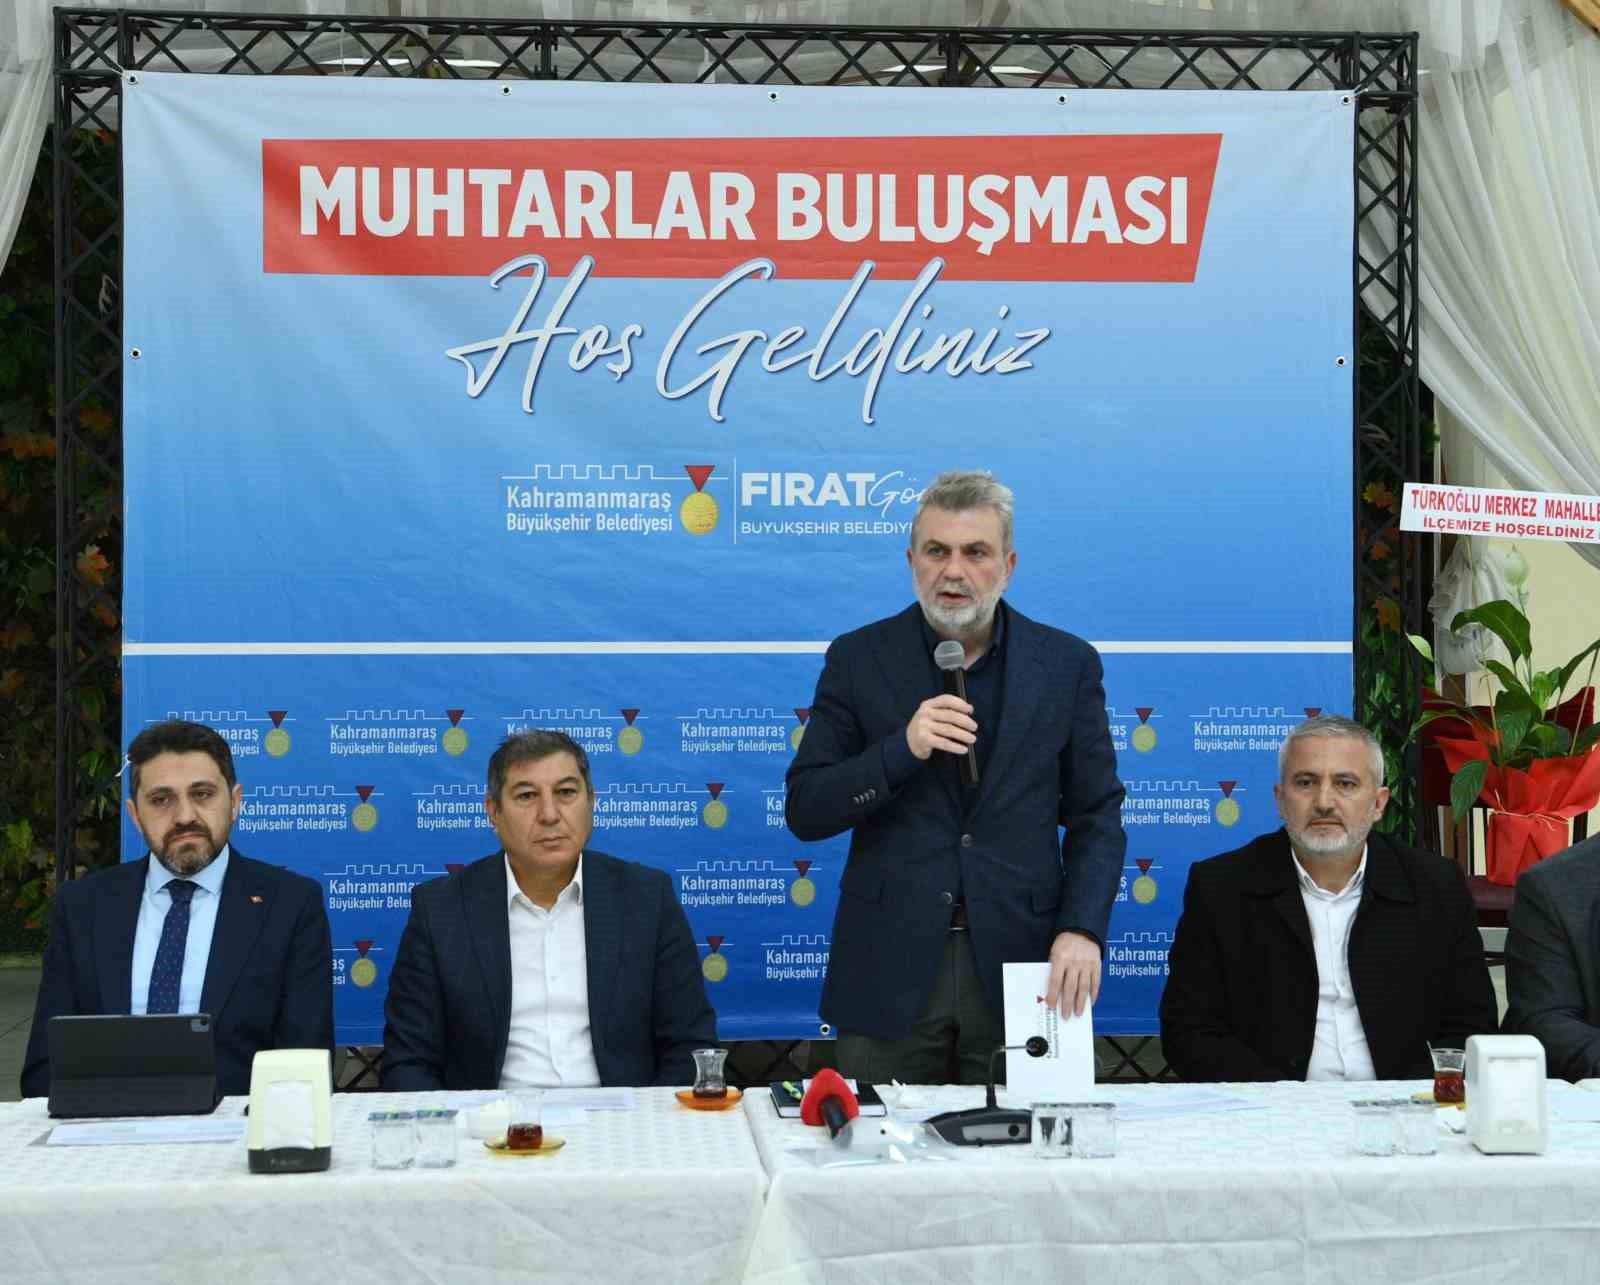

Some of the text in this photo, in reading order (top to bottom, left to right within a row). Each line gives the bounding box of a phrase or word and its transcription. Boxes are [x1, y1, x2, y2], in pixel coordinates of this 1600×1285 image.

[299, 165, 1188, 256] MUHTARLAR BULUŞMASI
[445, 254, 1051, 424] Hoş Geldiniz
[741, 472, 876, 507] FIRAT
[507, 486, 672, 511] Kahramanmaraş
[1411, 485, 1480, 514] TÜRKOĞLU
[1485, 495, 1537, 517] MERKEZ
[507, 513, 673, 535] Büyükşehir Belediyesi
[330, 723, 437, 741] Kahramanmaraş
[681, 722, 785, 739] Kahramanmaraş
[388, 741, 438, 757] Belediyesi
[737, 740, 786, 754] Belediyesi
[239, 800, 346, 816] Kahramanmaraş
[417, 799, 487, 814] Kahraman
[593, 798, 698, 814] Kahramanmaraş
[296, 817, 347, 833] Belediyesi
[649, 814, 698, 830] Belediyesi
[1163, 813, 1211, 828] Belediyesi
[681, 876, 785, 891] Kahramanmaraş
[737, 891, 785, 907] Belediyesi
